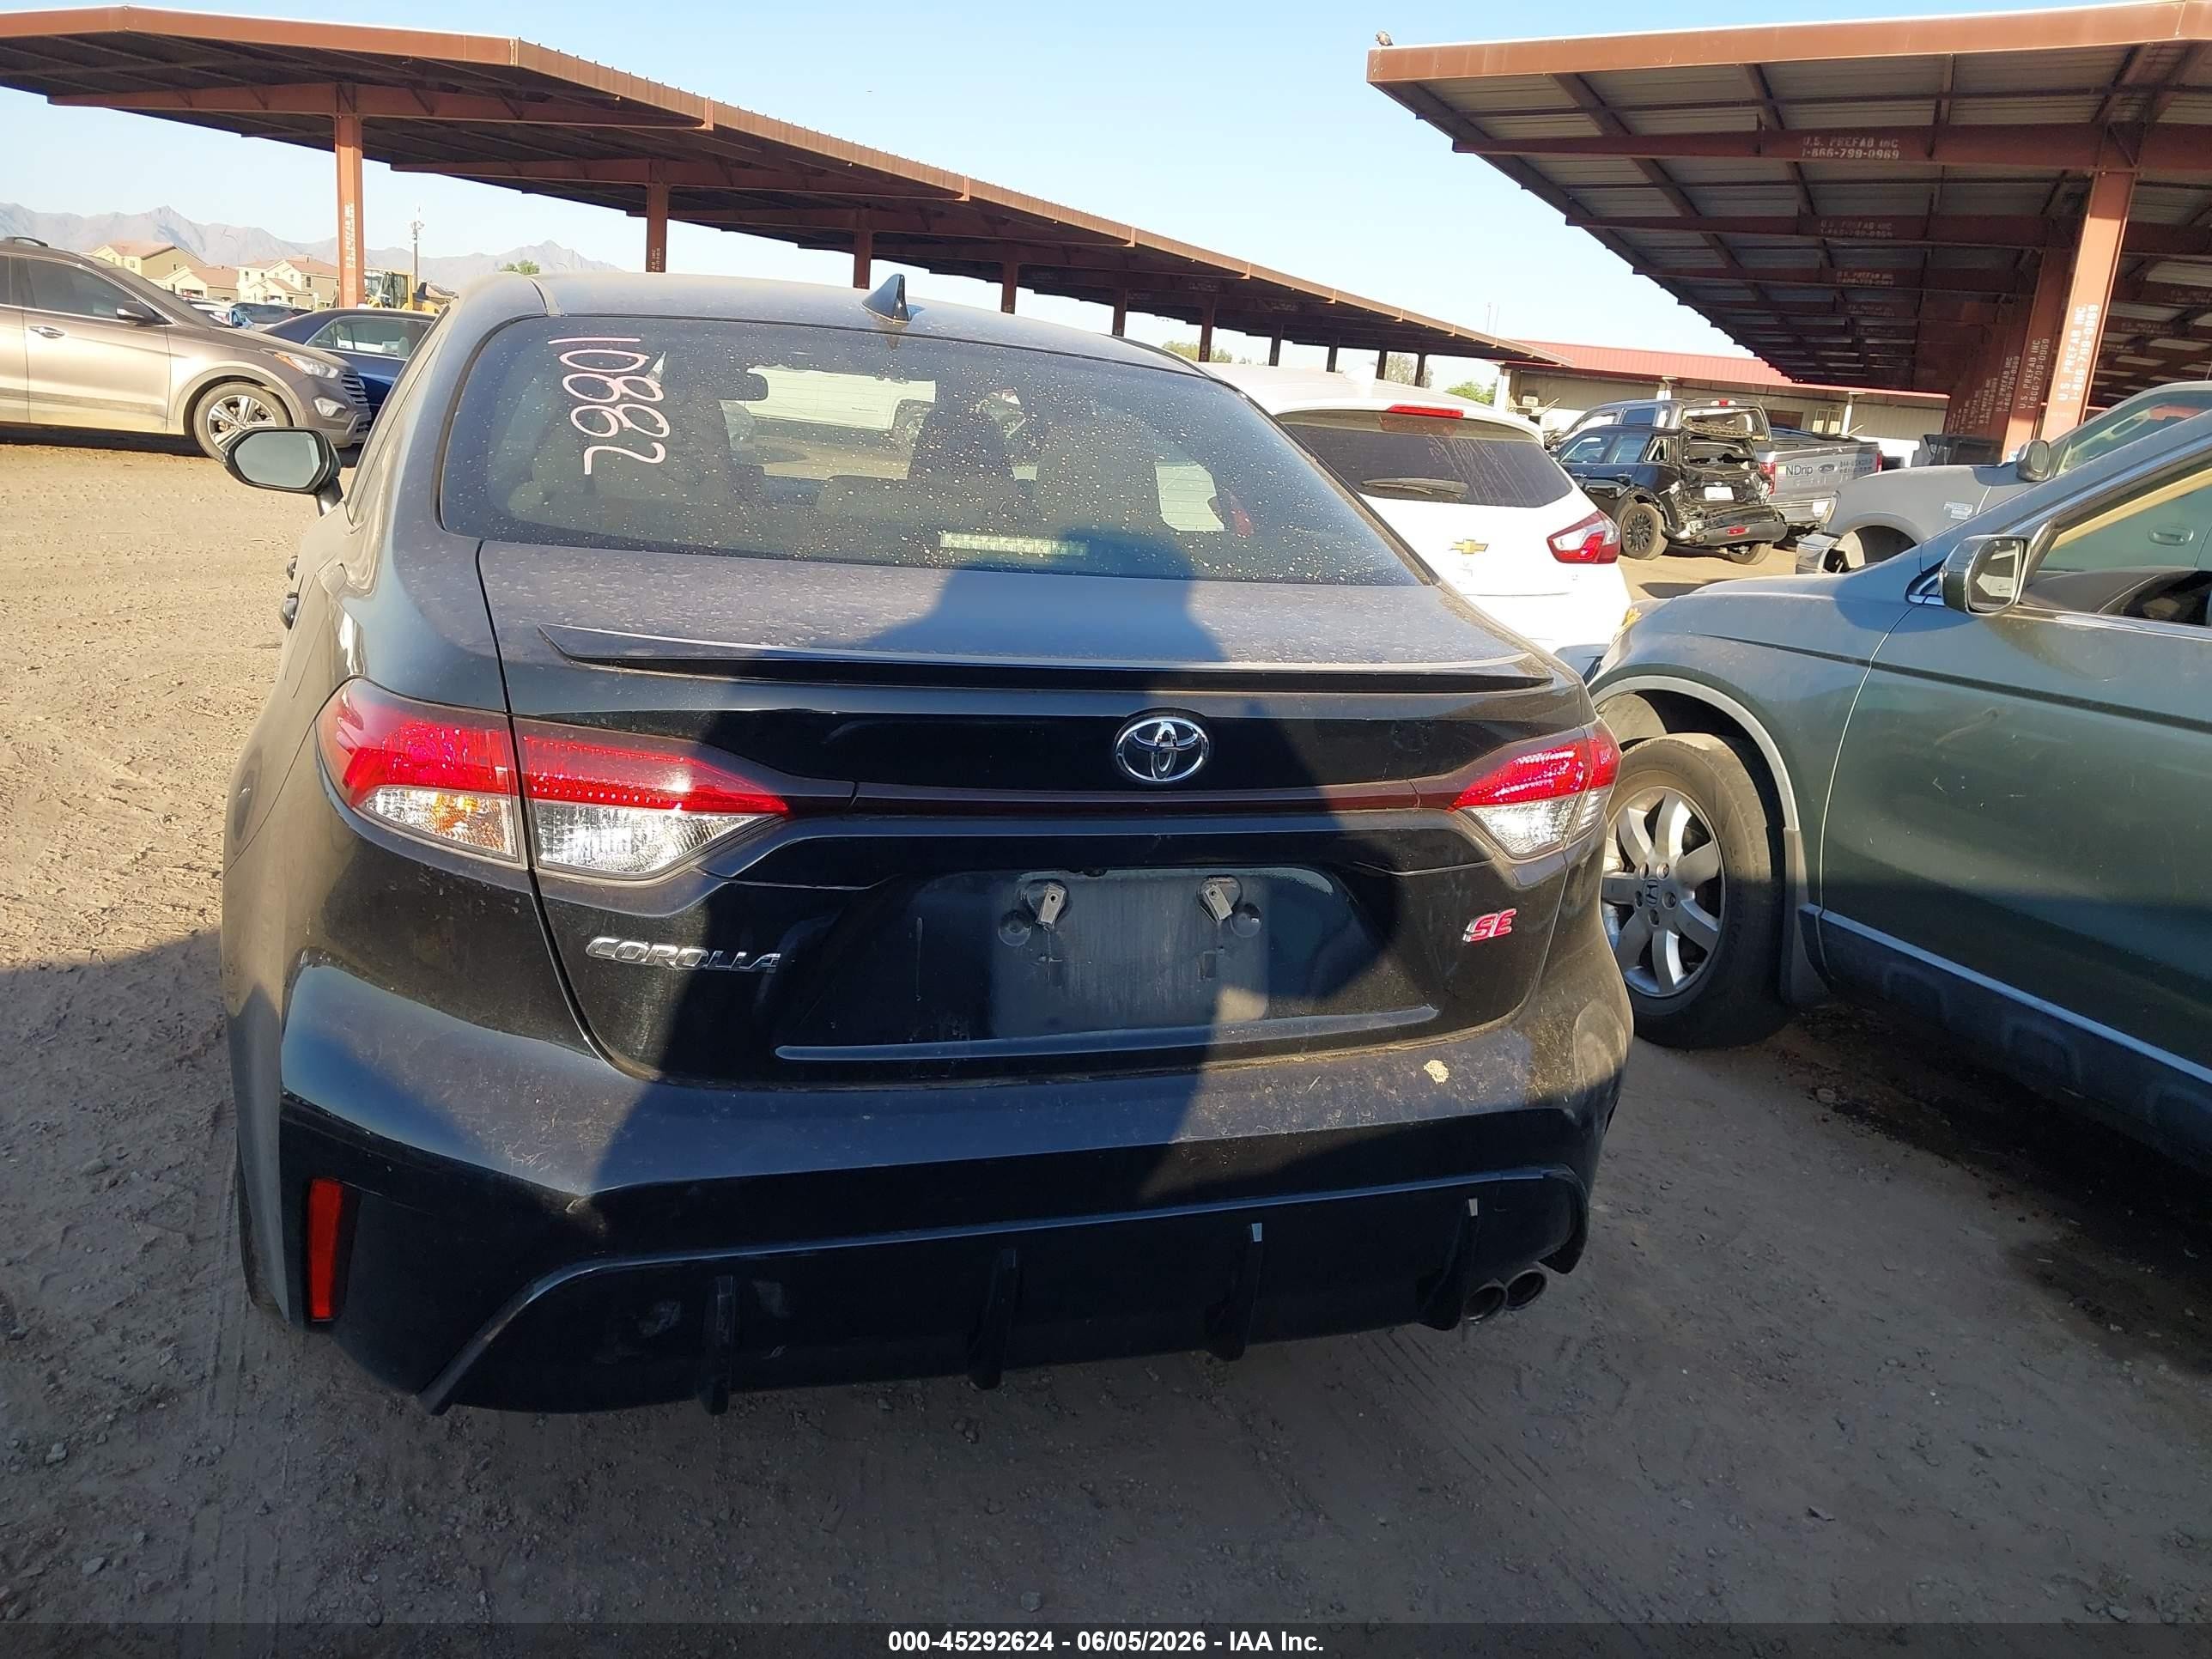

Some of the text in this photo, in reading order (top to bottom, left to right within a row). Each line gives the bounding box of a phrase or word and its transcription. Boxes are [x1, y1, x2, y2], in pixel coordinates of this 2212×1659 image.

[1802, 148, 1900, 160] 1-866-799-0969
[1829, 137, 1875, 148] PREFAB
[2063, 329, 2082, 374] PREFAB
[2023, 356, 2038, 390] PREFAB
[547, 337, 671, 475] 10882
[1462, 908, 1517, 943] SE
[586, 937, 781, 973] COROLLA
